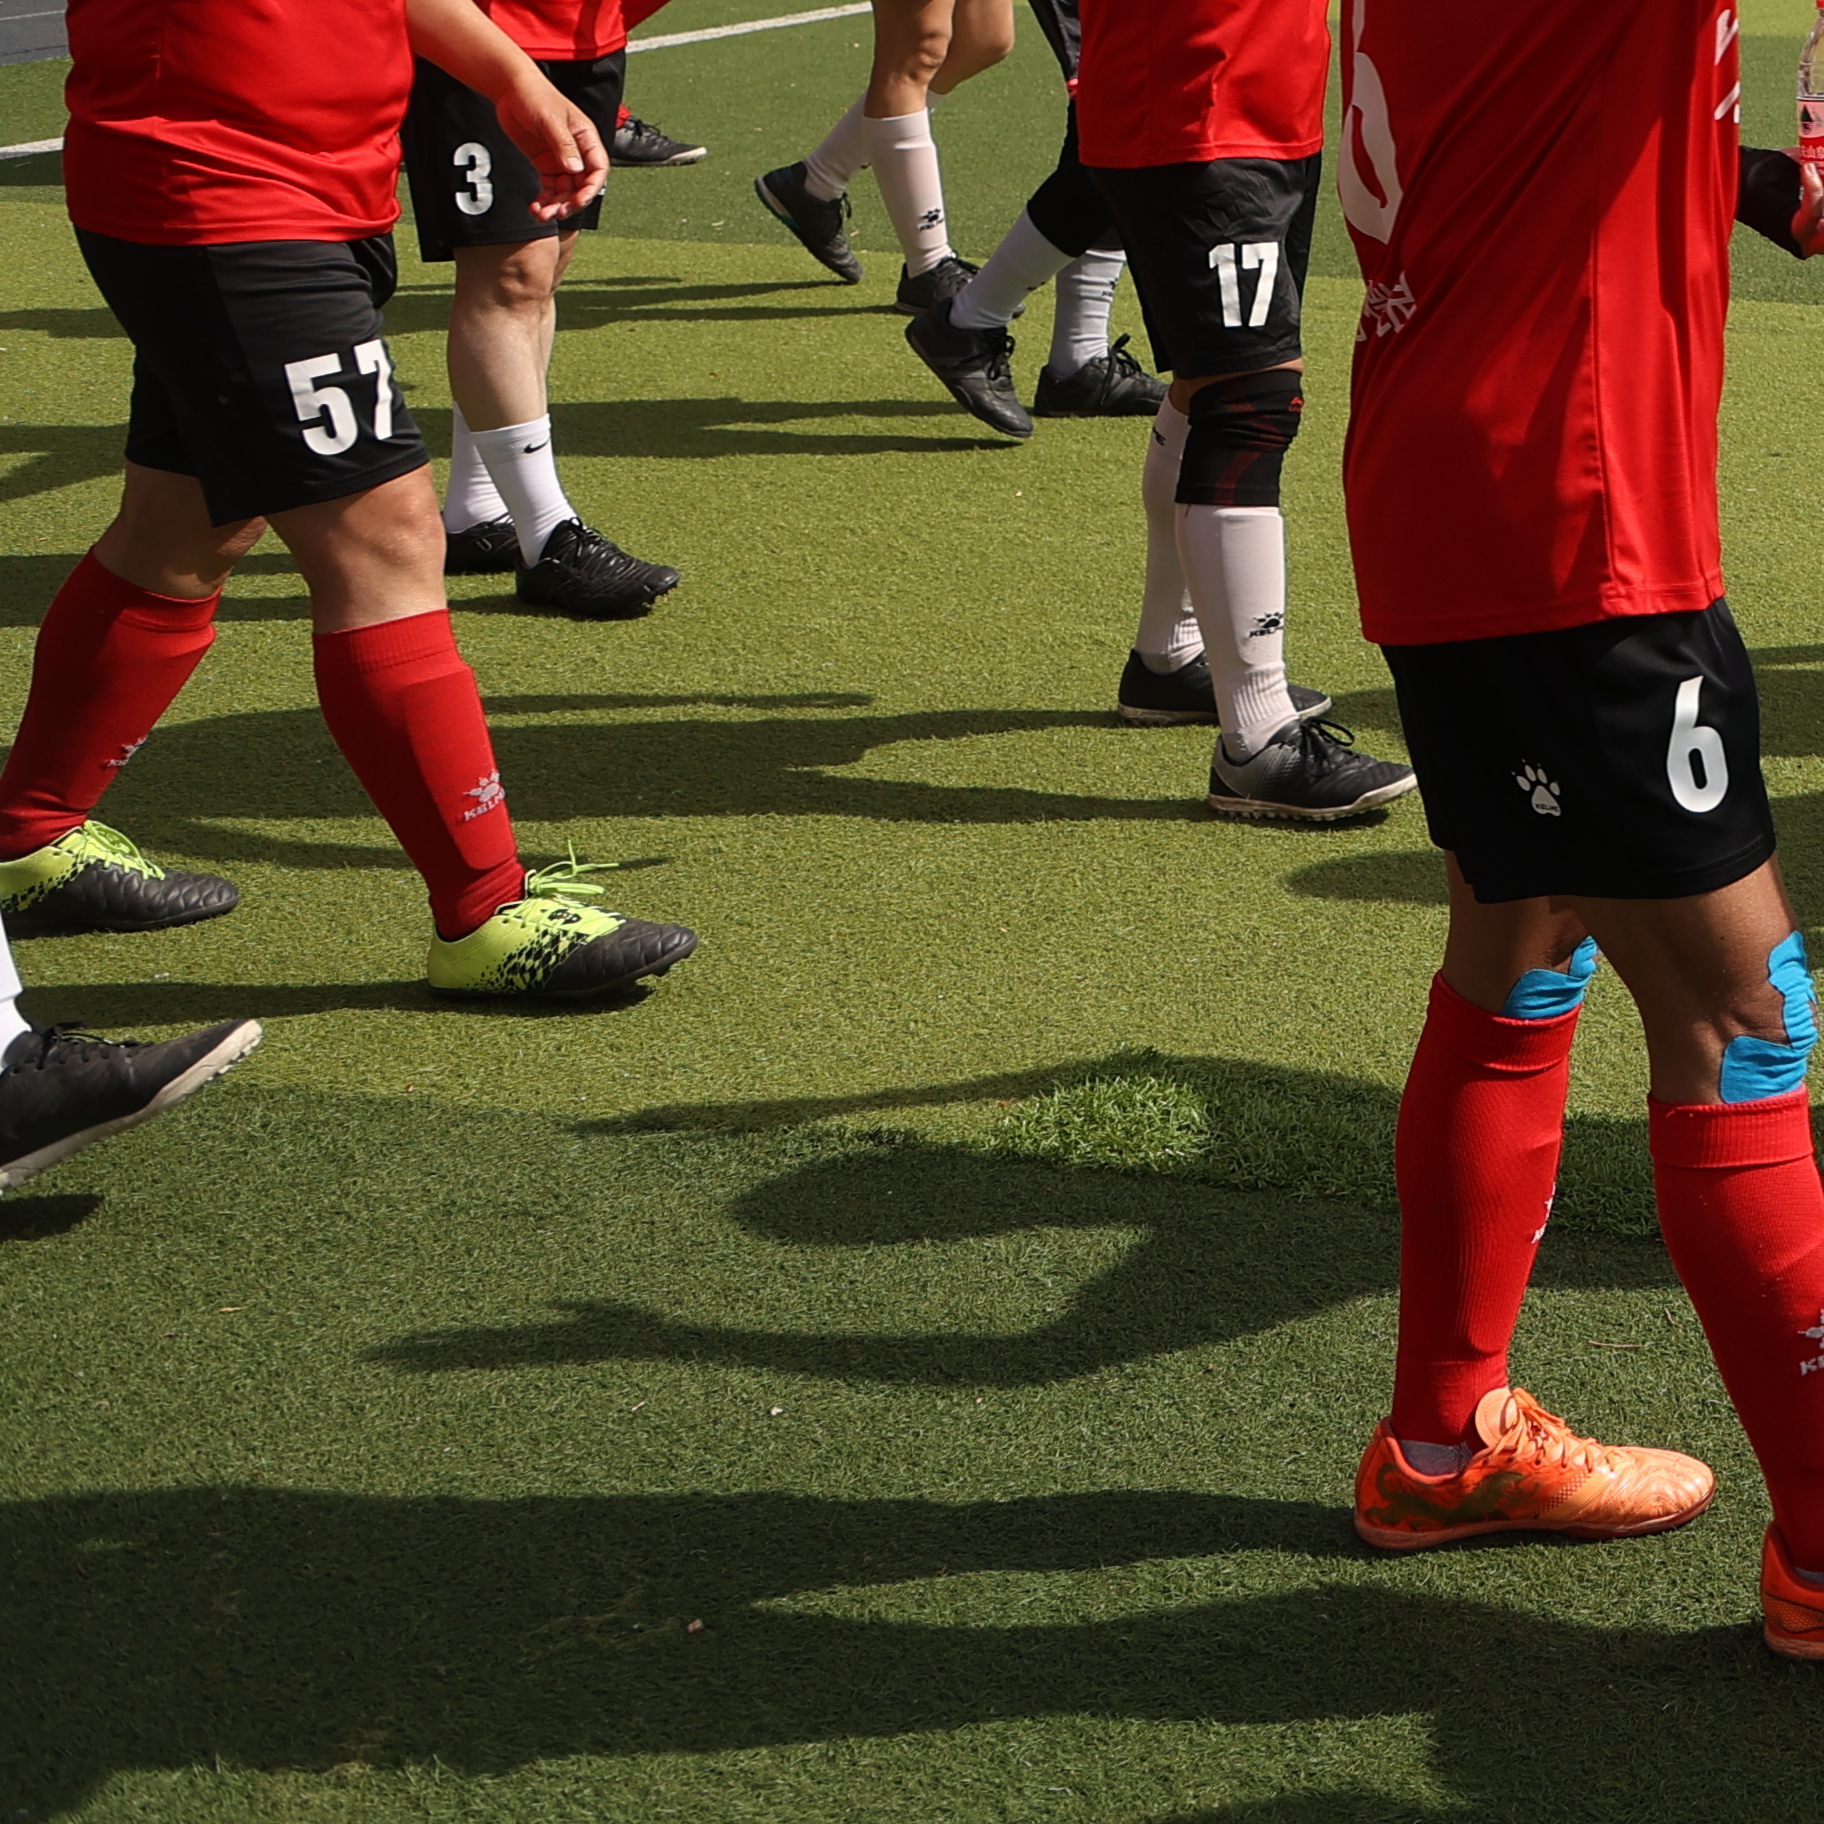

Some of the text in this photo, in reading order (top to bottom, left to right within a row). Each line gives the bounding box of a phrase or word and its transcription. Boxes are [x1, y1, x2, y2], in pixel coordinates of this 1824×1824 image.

[454, 142, 493, 215] 3
[1209, 242, 1279, 328] 17
[284, 338, 393, 456] 57
[1667, 676, 1729, 813] 6
